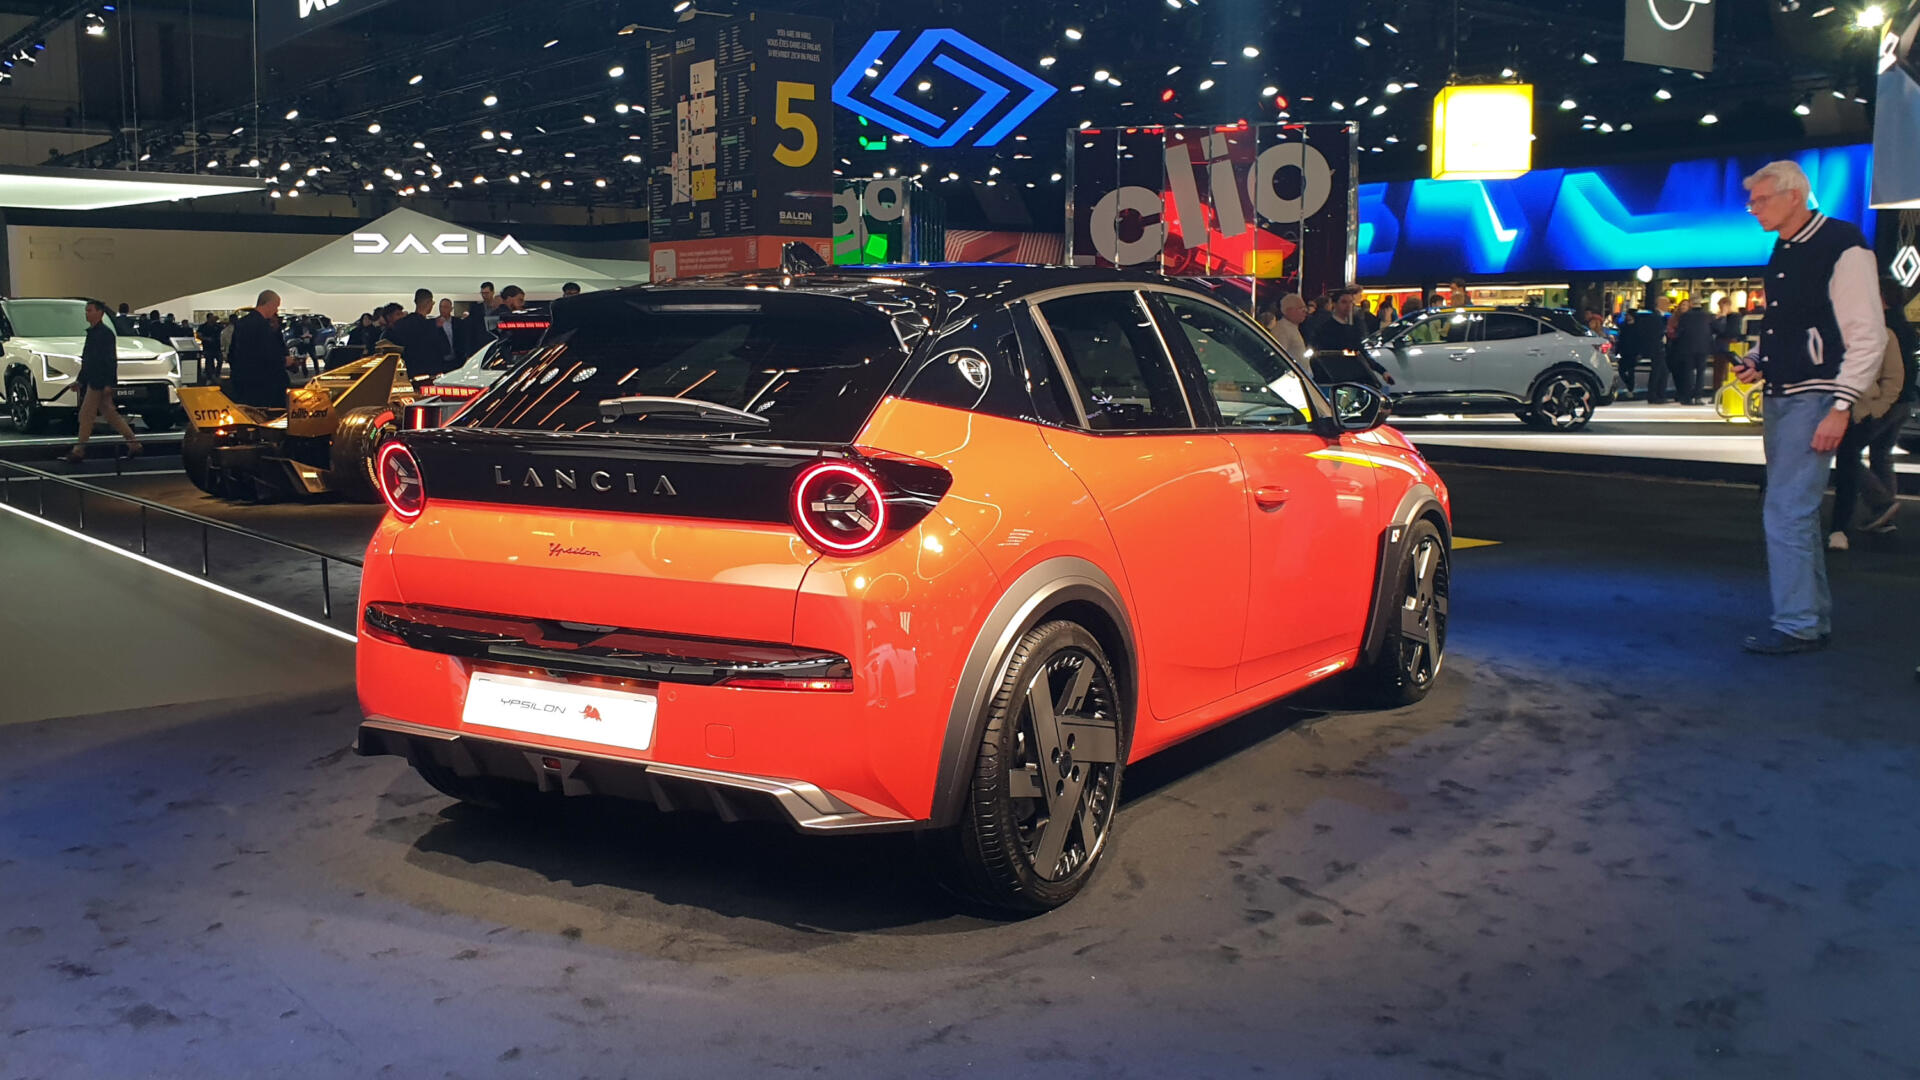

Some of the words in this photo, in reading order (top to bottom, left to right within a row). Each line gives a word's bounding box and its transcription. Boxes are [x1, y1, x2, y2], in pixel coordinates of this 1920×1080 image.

[693, 74, 700, 84] 11
[773, 81, 818, 168] 5
[1090, 132, 1332, 266] clio
[779, 210, 812, 220] SALON
[353, 232, 529, 255] DACIA
[494, 465, 677, 496] LANCIA
[549, 542, 601, 557] Ypsilon
[500, 697, 567, 714] YPSILON
